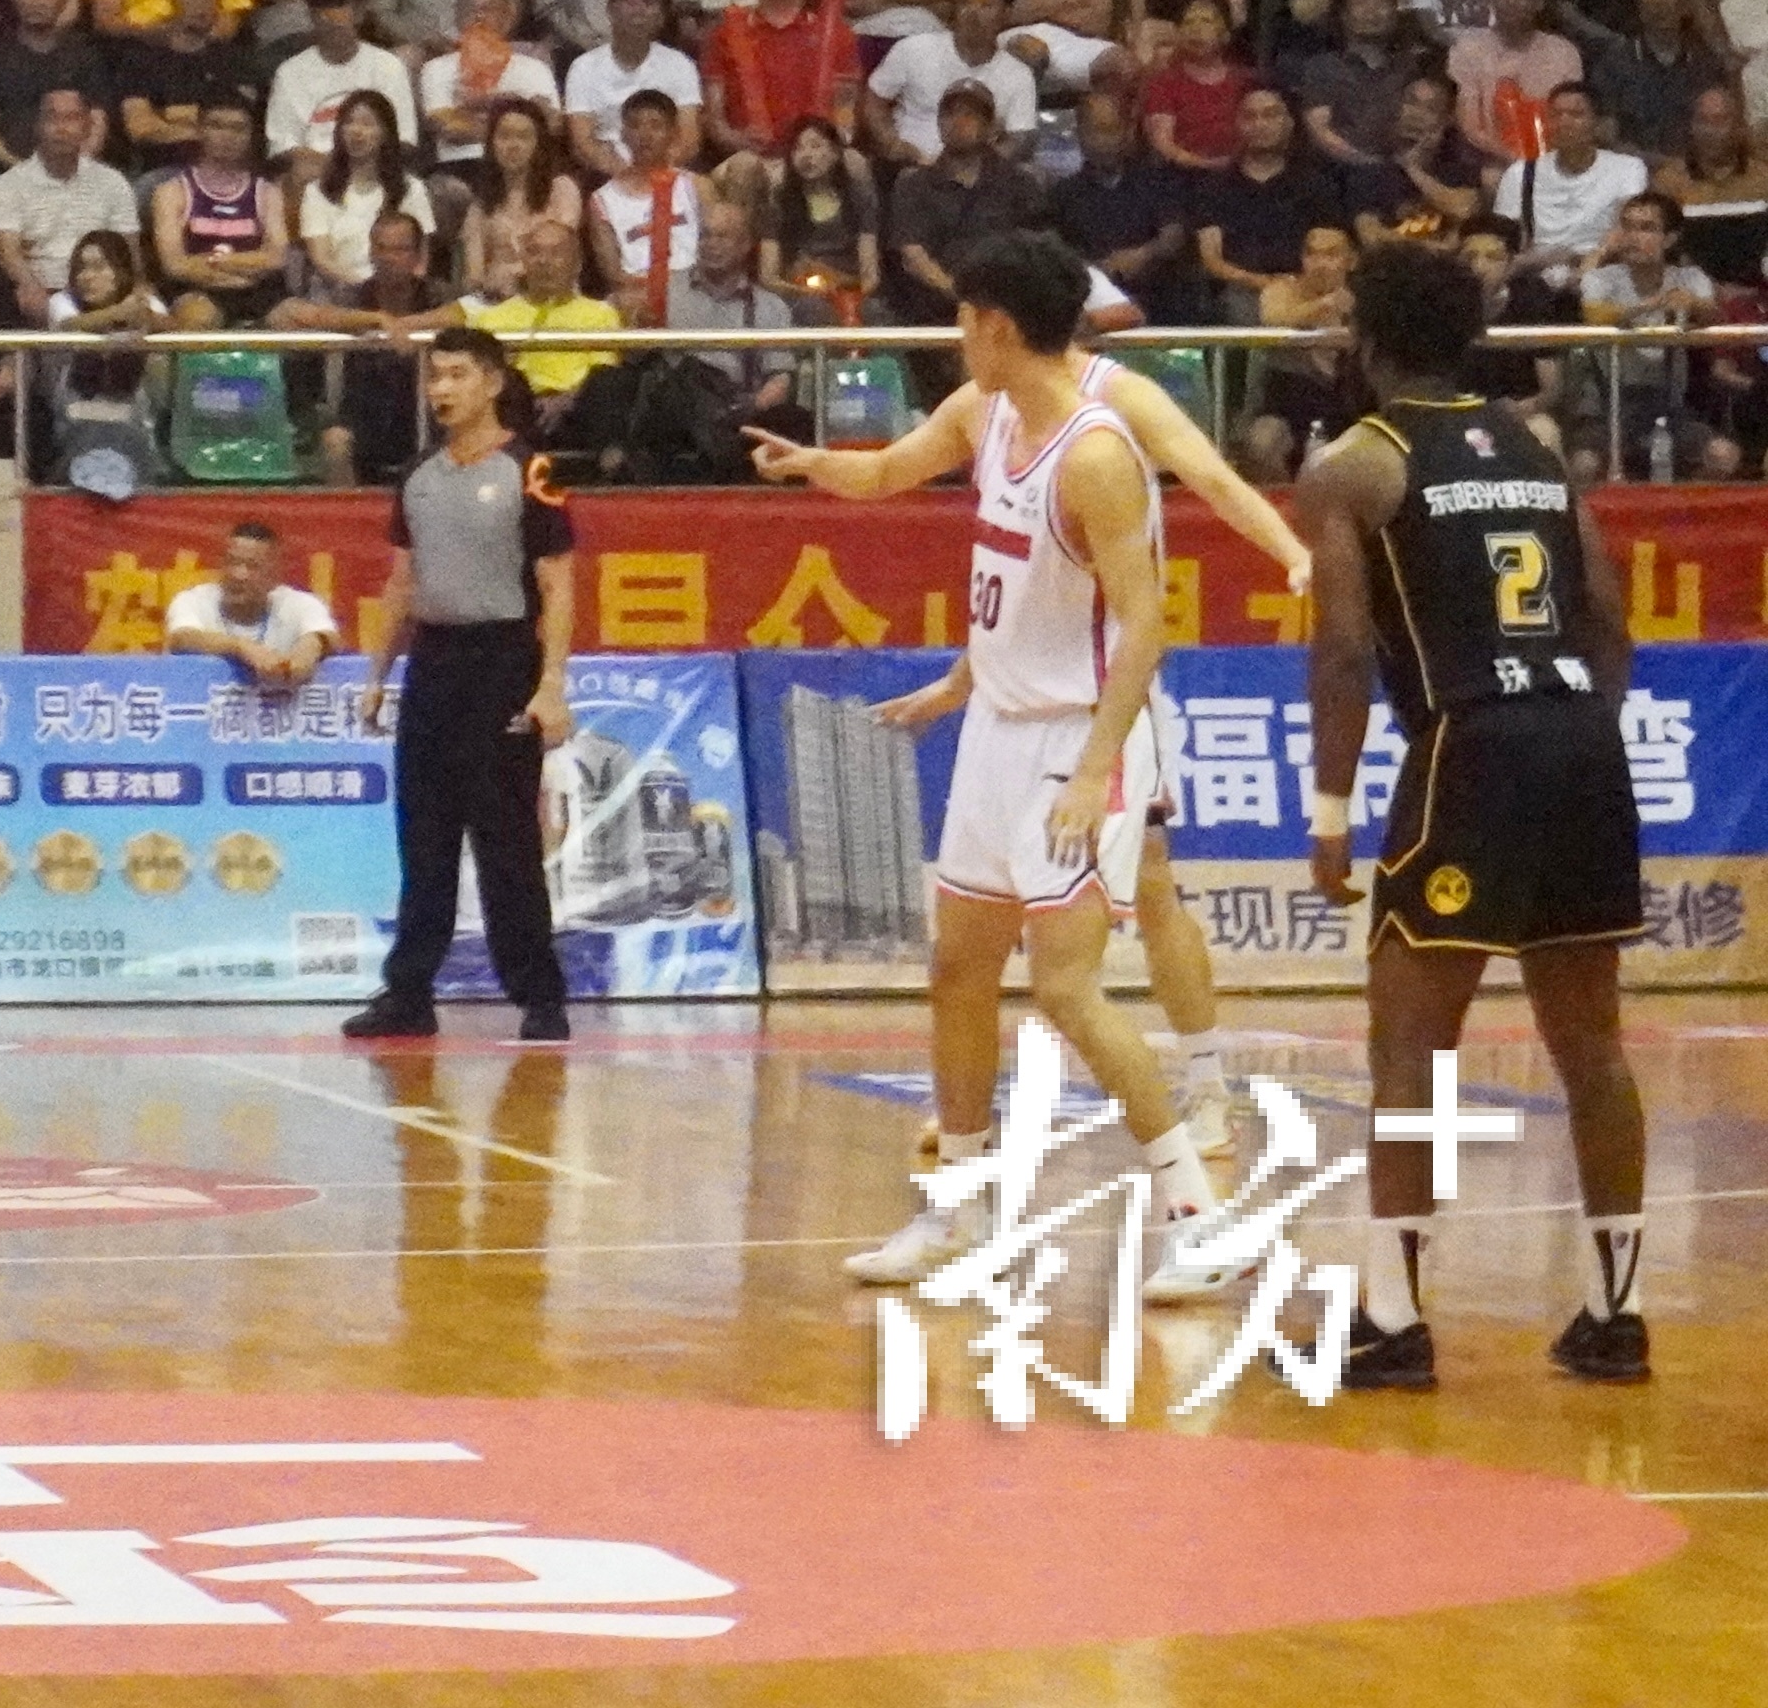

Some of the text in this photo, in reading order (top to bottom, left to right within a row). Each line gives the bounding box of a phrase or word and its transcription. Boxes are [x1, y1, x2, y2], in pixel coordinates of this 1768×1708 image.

[1484, 532, 1559, 635] 2
[245, 769, 363, 799] 口感顺滑
